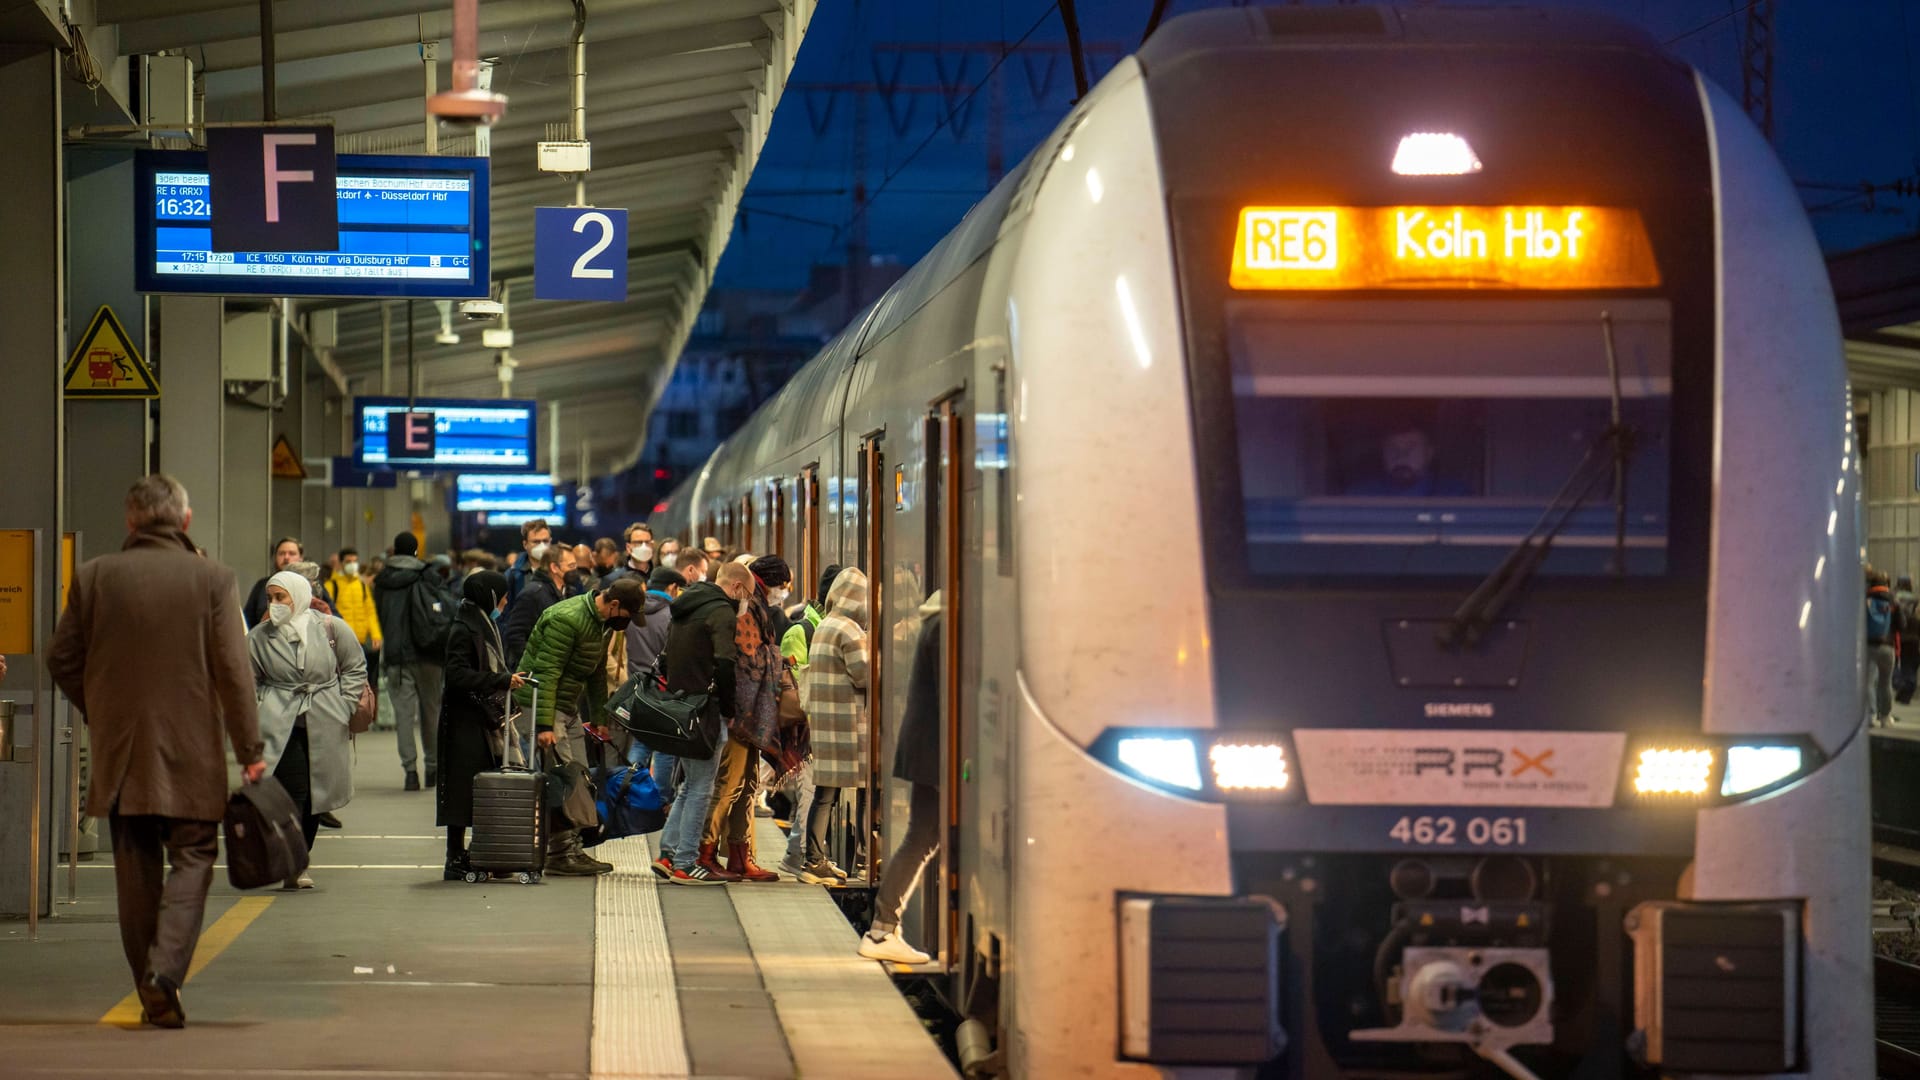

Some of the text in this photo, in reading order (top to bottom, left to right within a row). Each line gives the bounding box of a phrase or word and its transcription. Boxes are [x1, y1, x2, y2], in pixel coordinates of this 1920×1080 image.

[263, 133, 317, 223] F
[156, 186, 203, 196] RE 6 (RRX)
[381, 191, 430, 201] Düsseldorf
[432, 192, 448, 201] Hbf
[156, 198, 205, 216] 16:32
[1252, 217, 1328, 262] RE6
[1396, 211, 1584, 258] Köln Hbf
[571, 212, 614, 279] 2
[181, 252, 205, 261] 17:15
[208, 254, 232, 263] 17:20
[246, 253, 330, 264] ICE 1050 Köln Hbf
[338, 255, 410, 266] via Duisburg Hbf
[452, 257, 469, 266] G-C
[181, 264, 205, 273] 17:32
[246, 264, 257, 273] RE
[260, 265, 266, 274] 6
[405, 413, 429, 449] E
[576, 486, 593, 510] 2
[1424, 703, 1494, 717] SIEMENS
[1415, 747, 1554, 778] RRX
[1389, 816, 1526, 845] 462 061
